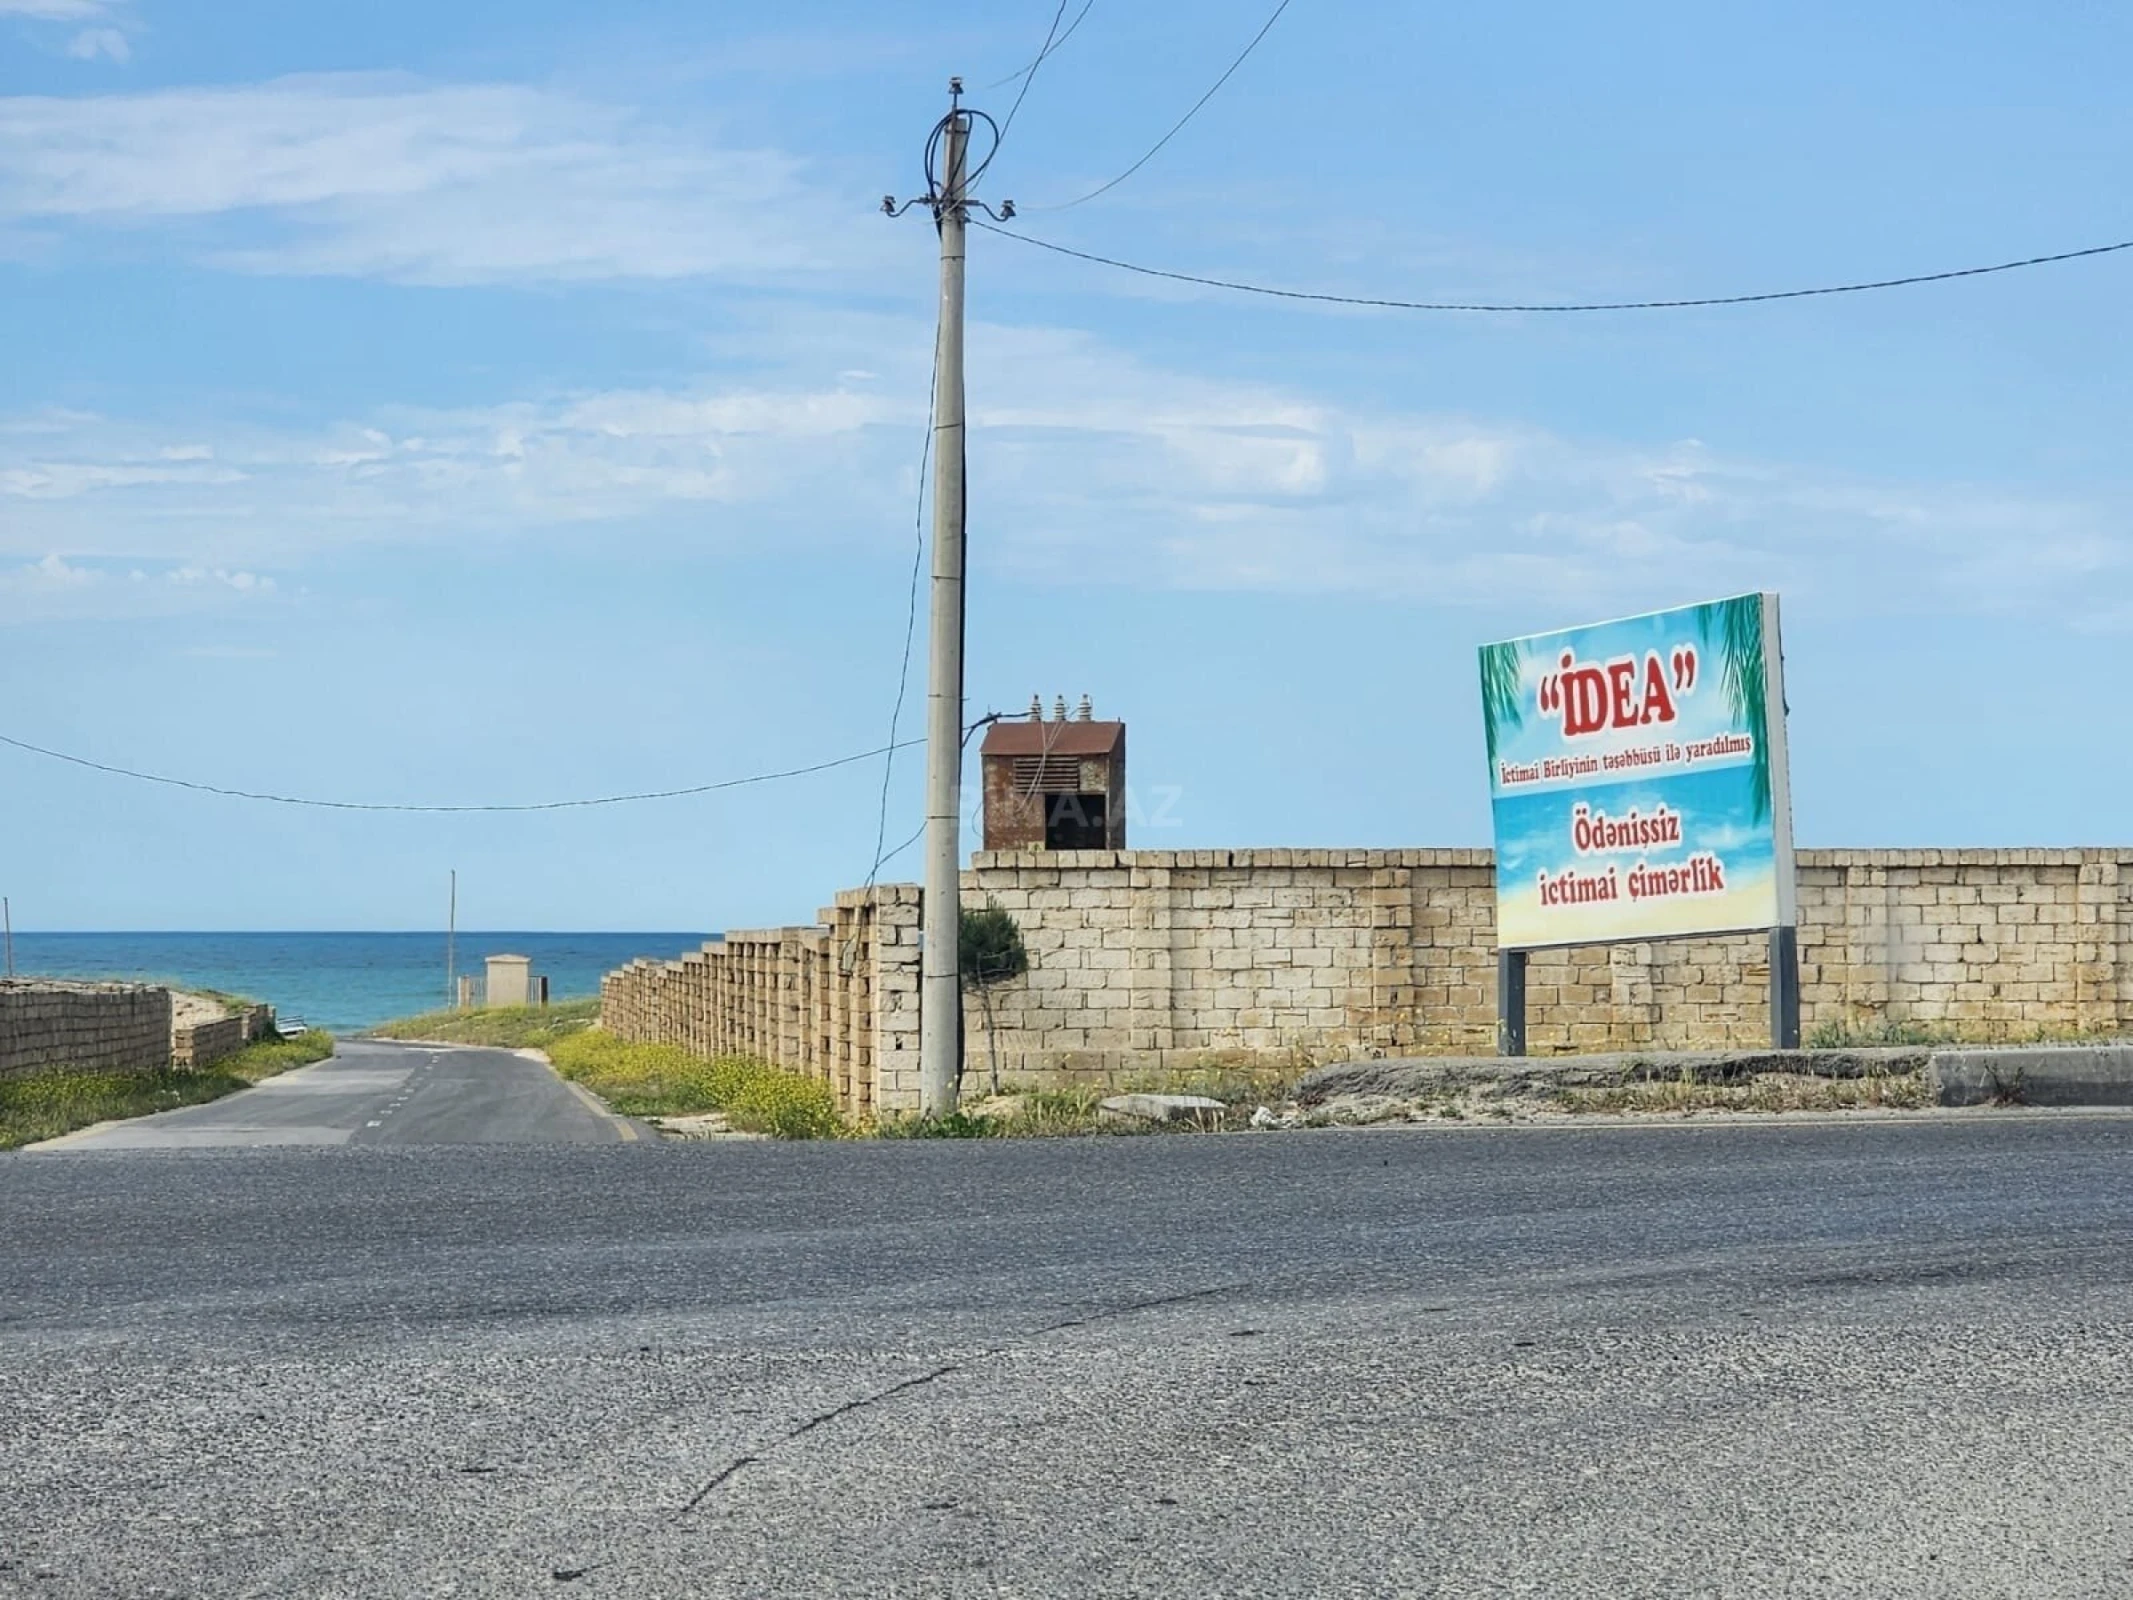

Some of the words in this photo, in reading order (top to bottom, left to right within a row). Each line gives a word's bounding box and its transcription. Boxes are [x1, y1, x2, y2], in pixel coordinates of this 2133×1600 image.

[1501, 762, 1539, 784] İctimai
[1543, 755, 1598, 778] Birliyinin
[1603, 746, 1661, 770] təşəbbüsü
[1665, 743, 1680, 761] ilə
[1686, 735, 1751, 763] yaradılmış
[1575, 808, 1680, 849] Ödənişsiz
[1540, 866, 1618, 905] ictimai
[1628, 855, 1724, 902] çimərlik
